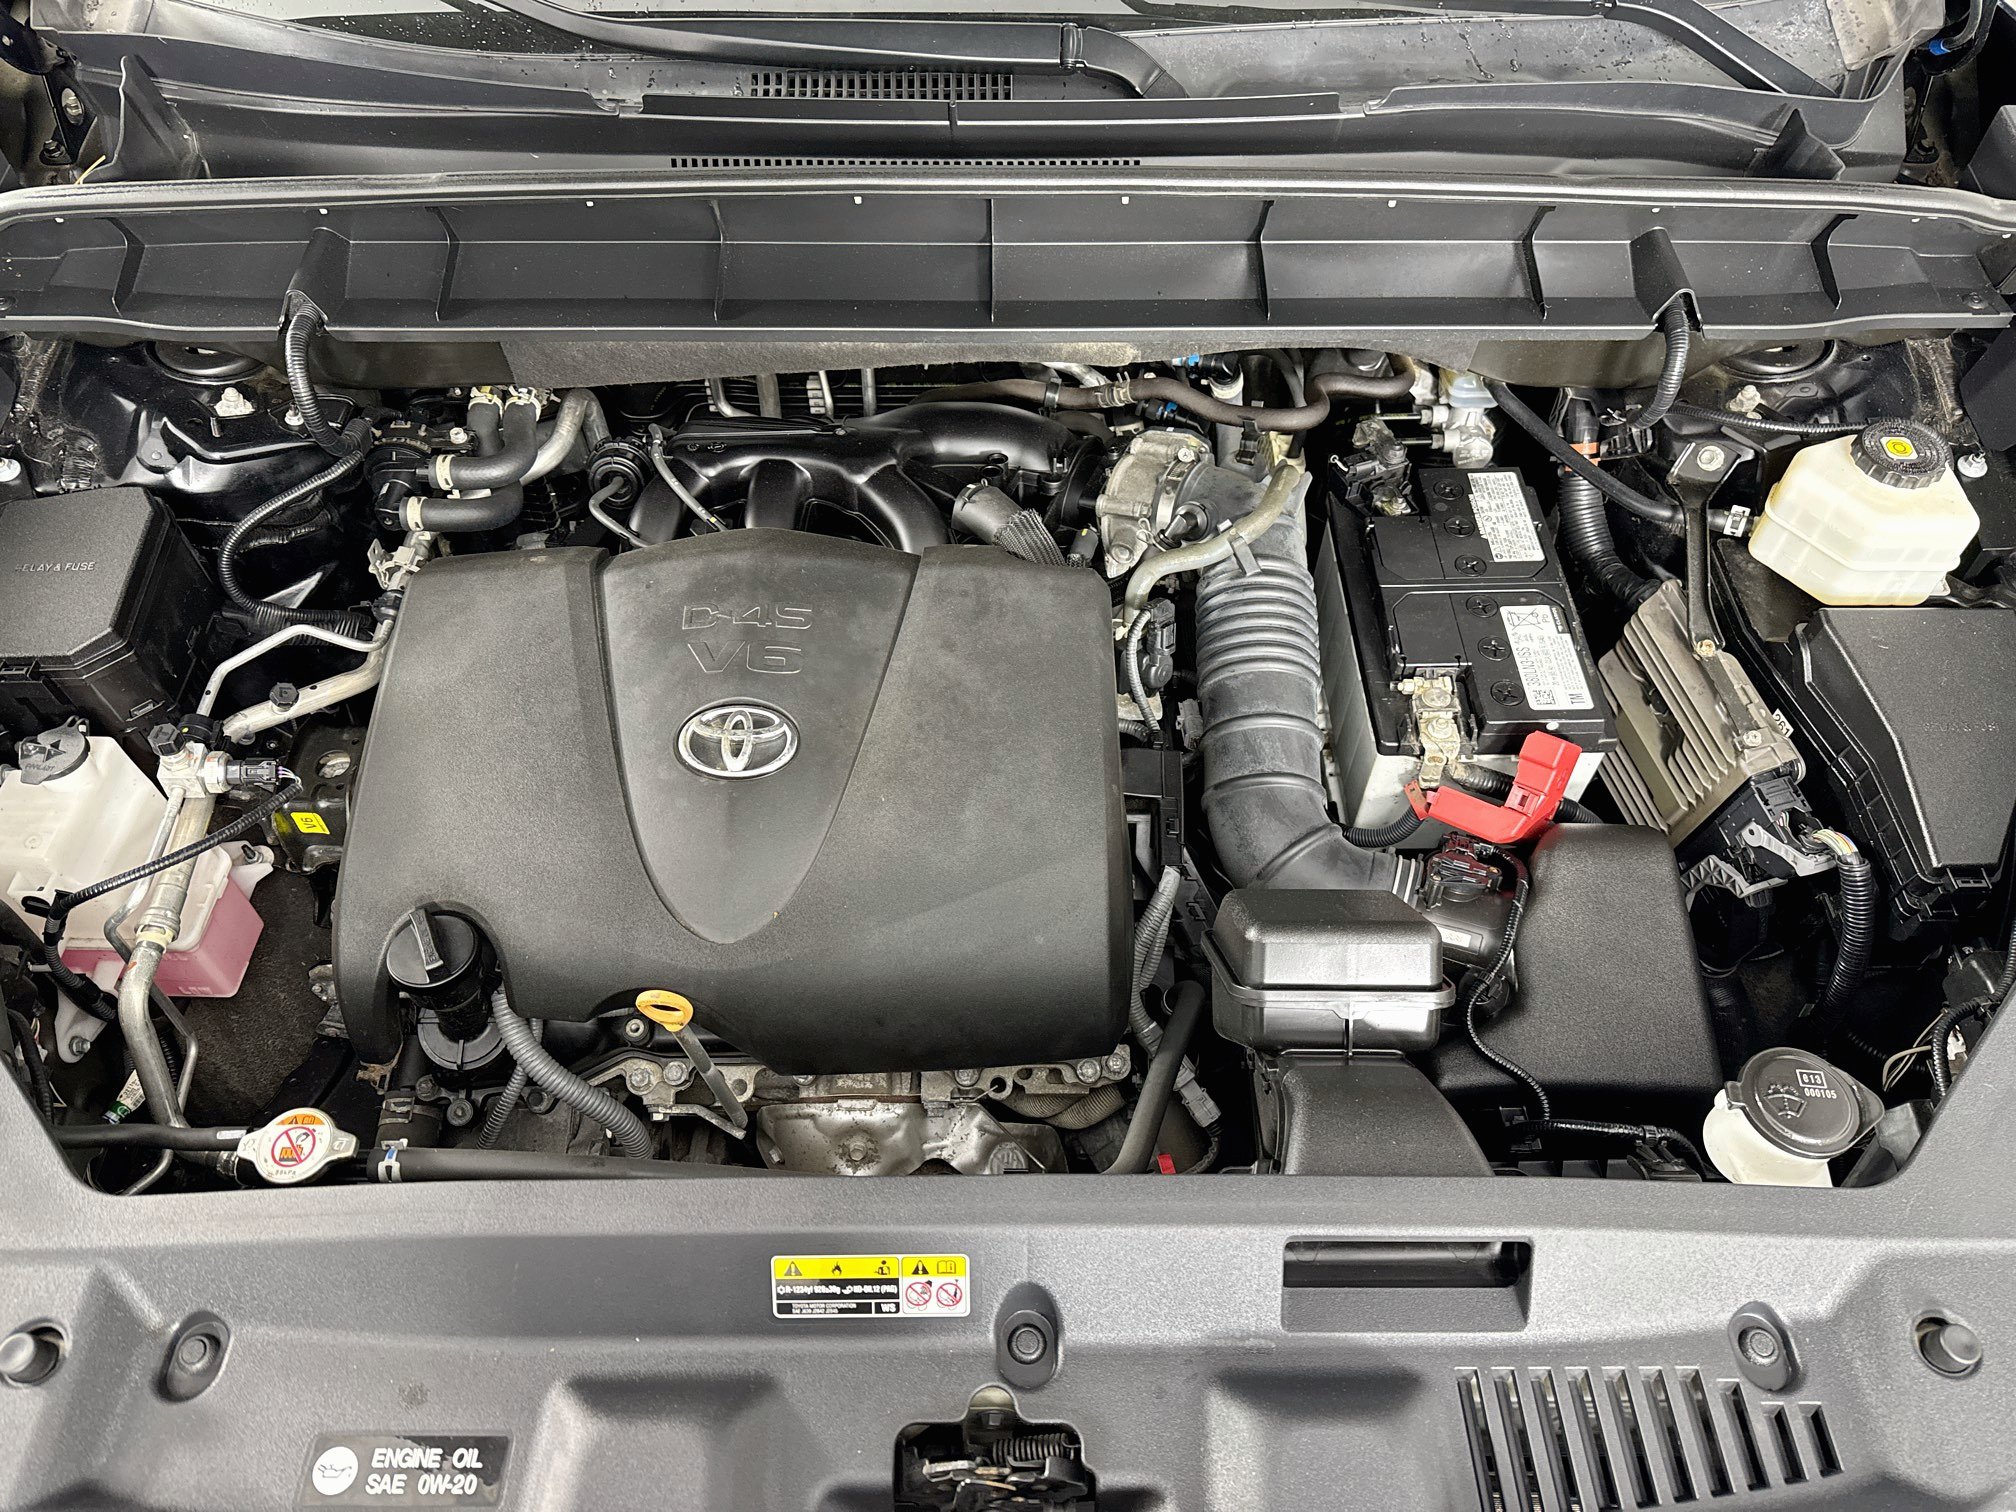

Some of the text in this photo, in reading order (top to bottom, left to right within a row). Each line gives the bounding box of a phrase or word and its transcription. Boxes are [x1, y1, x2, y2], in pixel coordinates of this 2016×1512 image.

[64, 561, 96, 571] FUSE
[682, 603, 813, 630] D-4S
[687, 640, 804, 674] V6
[301, 818, 316, 828] V6
[1804, 1088, 1837, 1099] 000105
[881, 1303, 897, 1312] WS
[371, 1447, 484, 1469] ENGINE OIL
[365, 1473, 478, 1495] SAE 0W-20
